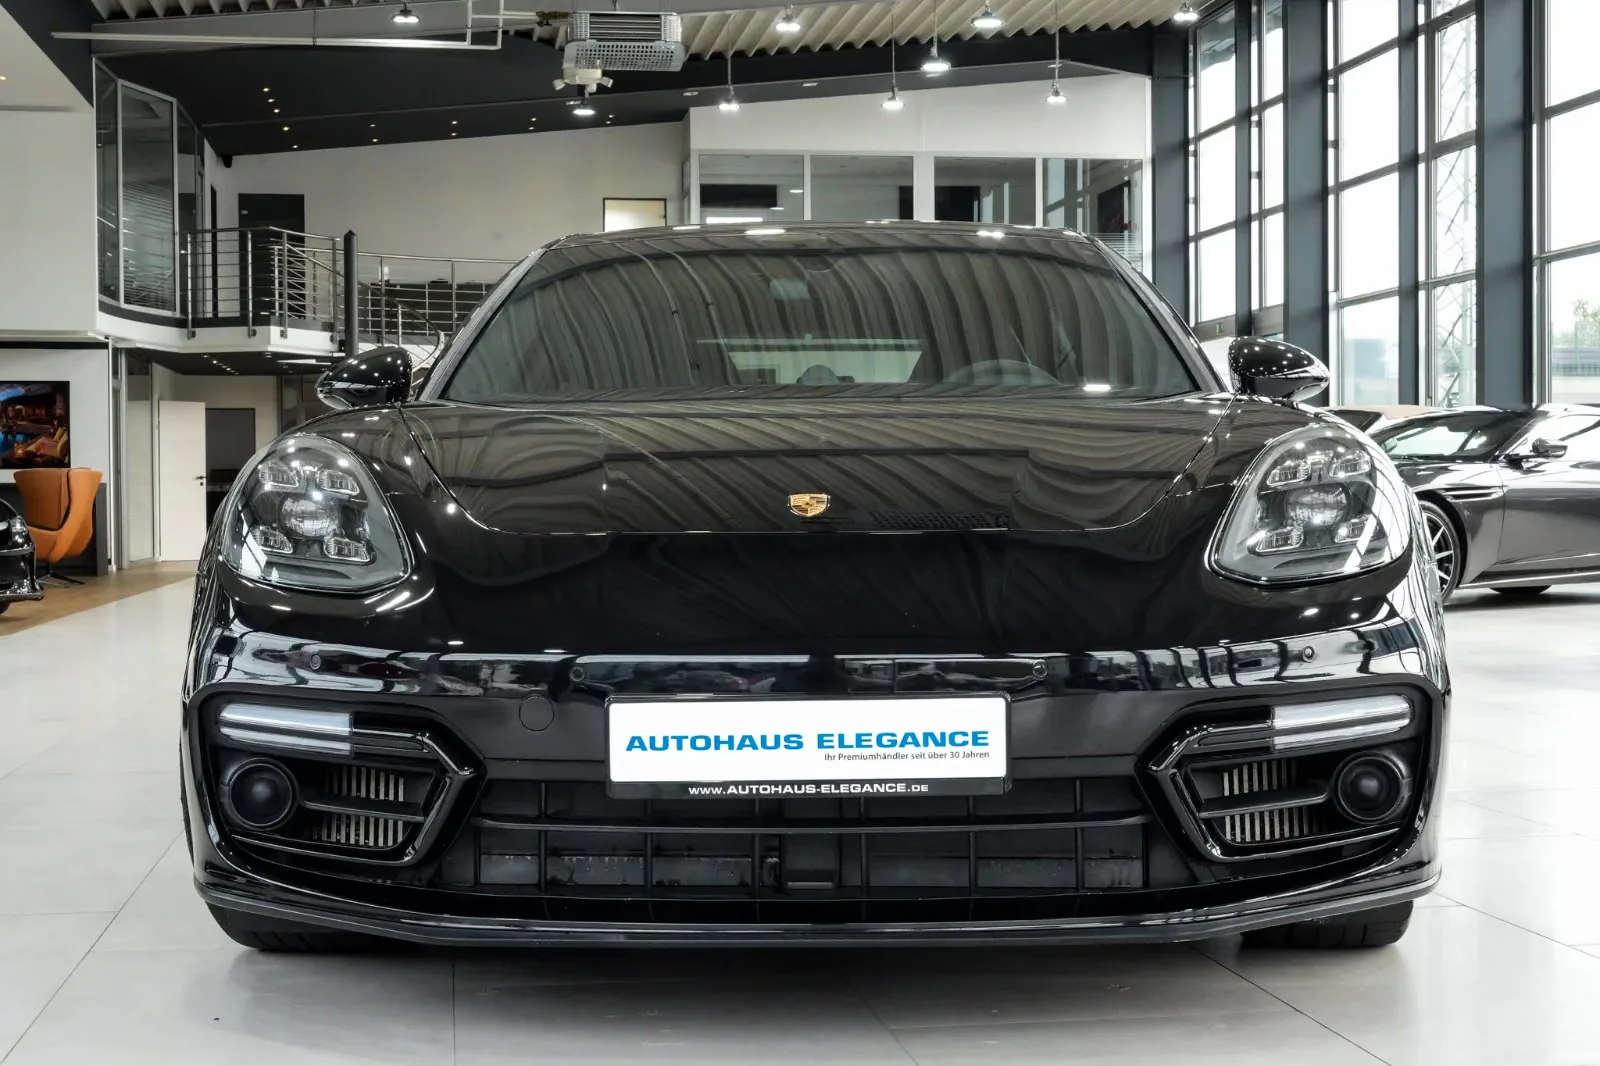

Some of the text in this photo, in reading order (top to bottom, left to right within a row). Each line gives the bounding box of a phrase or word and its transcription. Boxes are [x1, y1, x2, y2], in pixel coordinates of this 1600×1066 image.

[626, 731, 989, 751] AUTOHAUS ELEGANCE
[824, 752, 836, 760] Ihr
[838, 752, 908, 760] Premiumhändler
[910, 751, 926, 759] seit
[928, 751, 947, 759] über
[961, 750, 990, 758] Jahren
